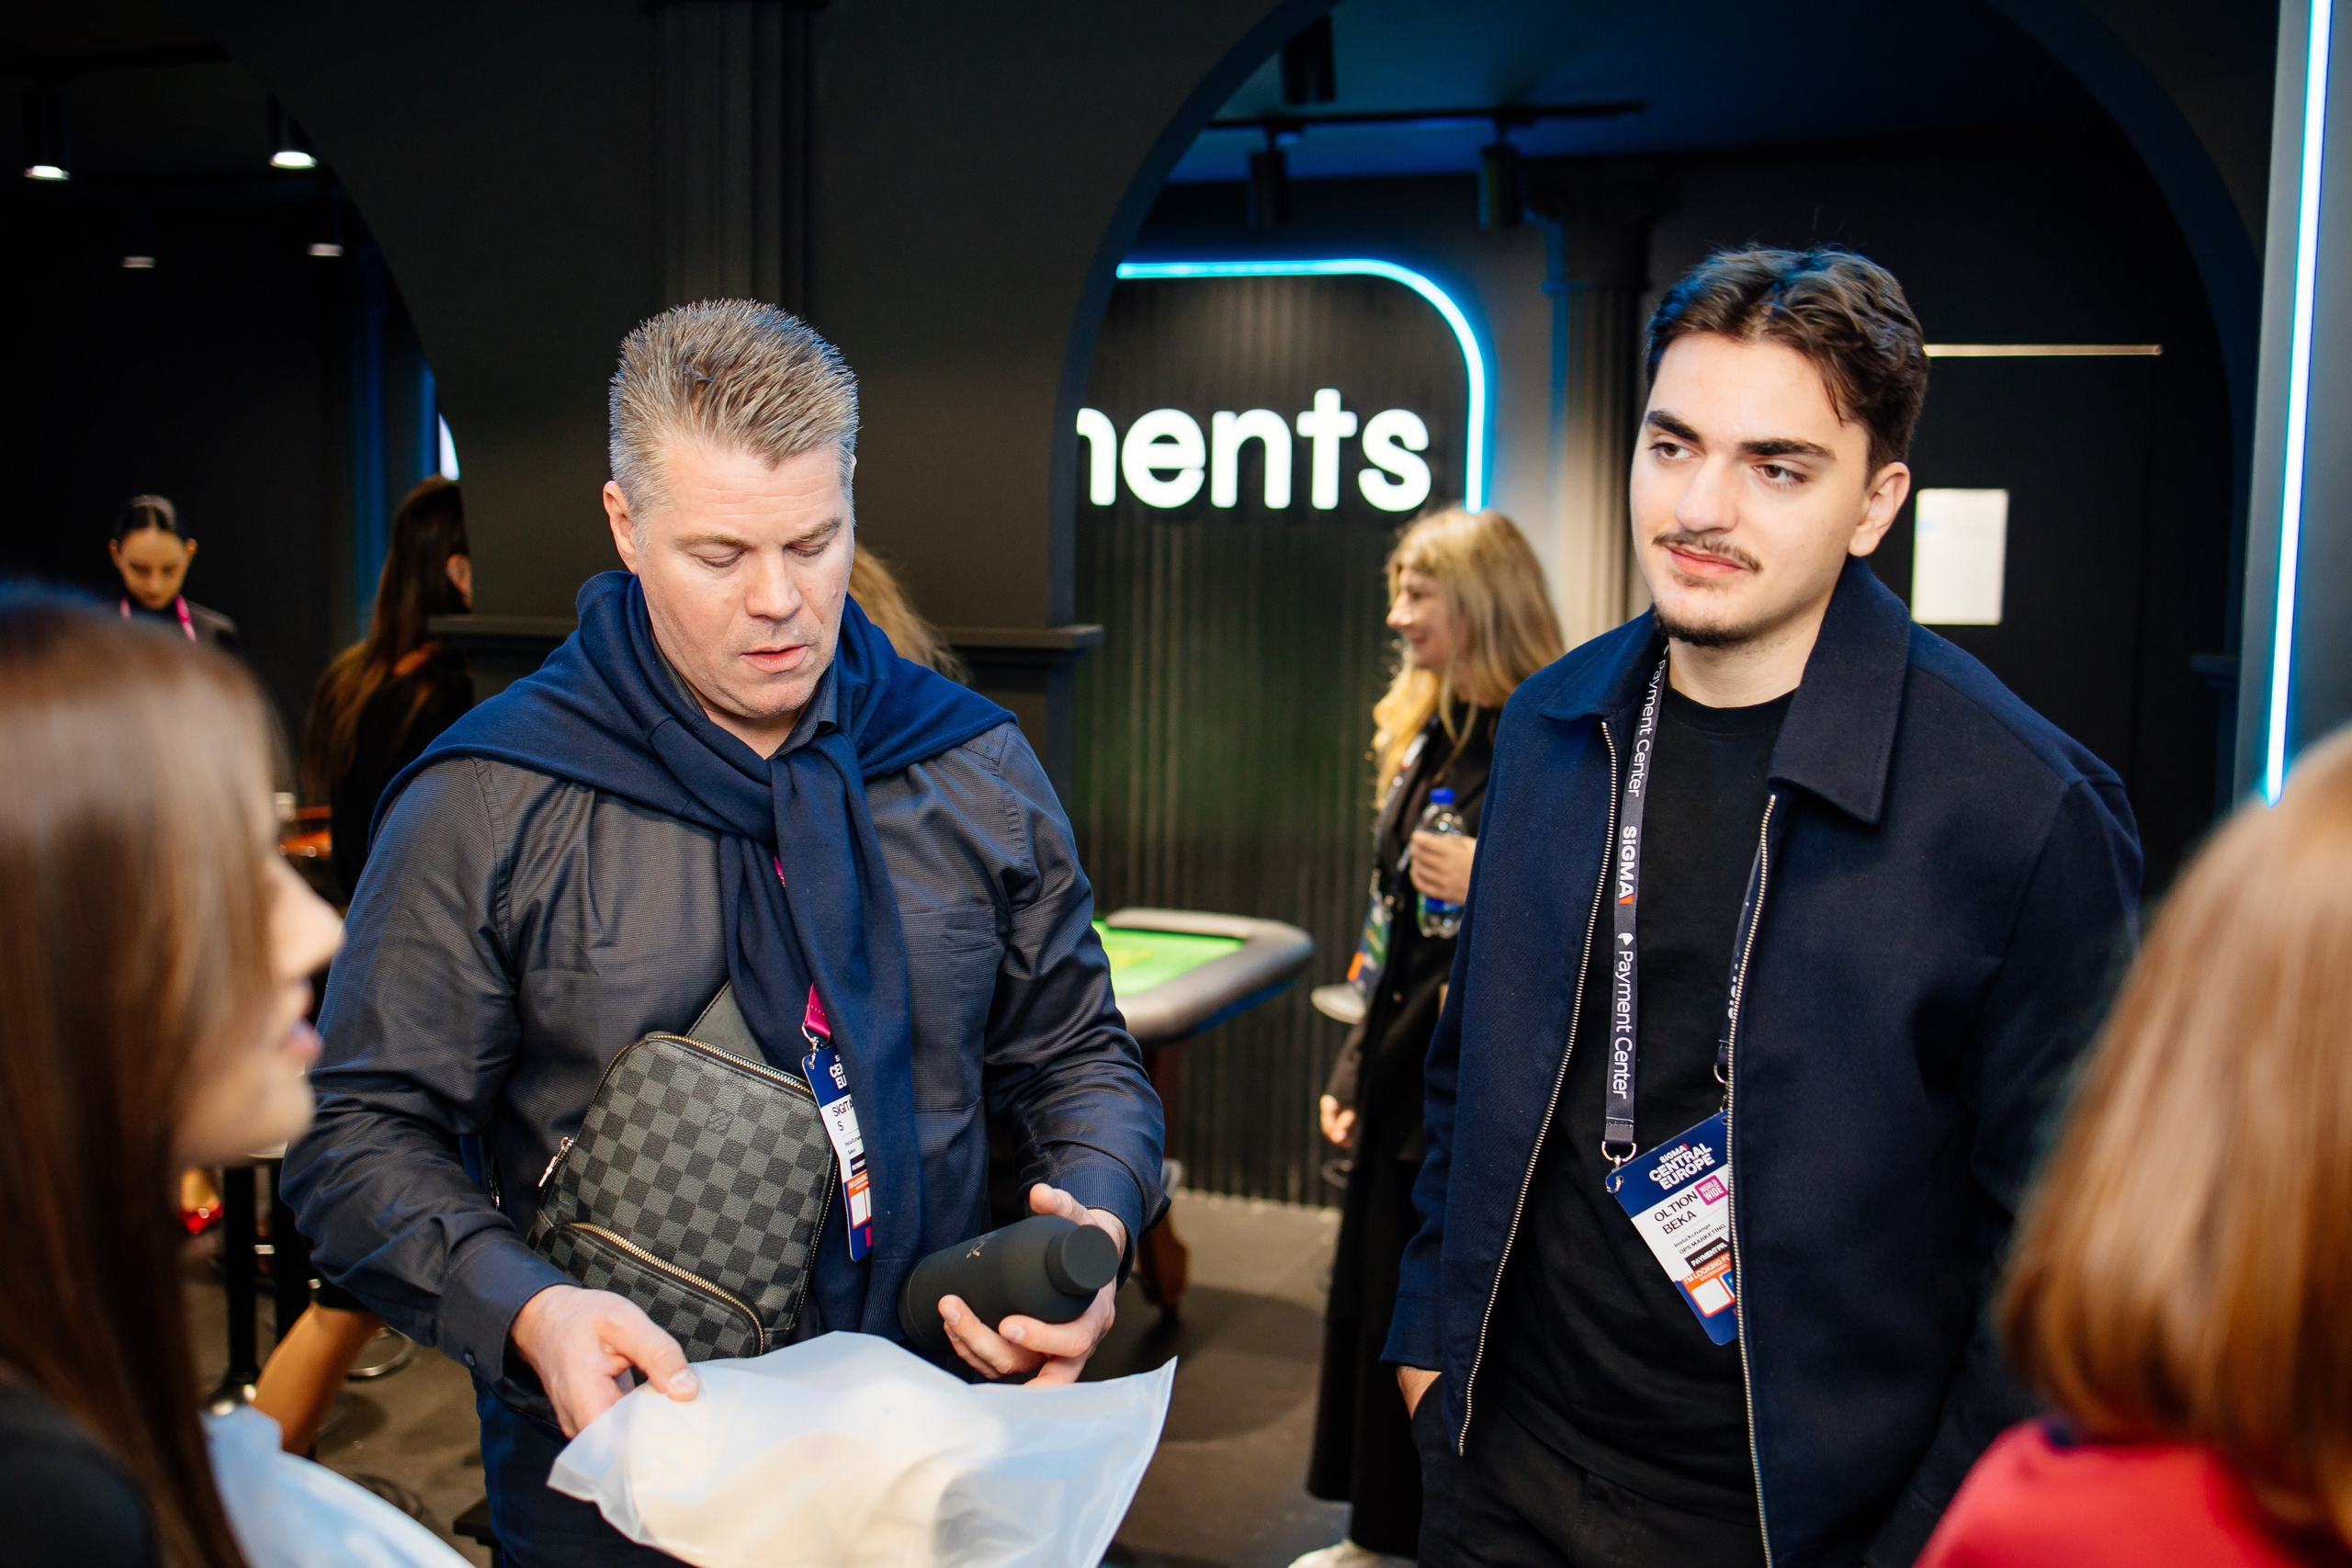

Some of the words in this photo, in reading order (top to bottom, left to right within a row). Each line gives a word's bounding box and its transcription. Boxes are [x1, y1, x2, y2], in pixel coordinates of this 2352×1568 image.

[1639, 660, 1667, 735] Payment
[1628, 739, 1650, 798] Center
[1614, 951, 1634, 1033] Payment
[1612, 1038, 1634, 1100] Center
[1649, 1143, 1713, 1181] CENTRAL
[1658, 1153, 1715, 1190] EUROPE
[1698, 1179, 1718, 1193] WORLD
[1703, 1186, 1724, 1202] WIDE
[1654, 1190, 1698, 1222] OLTION
[1662, 1211, 1697, 1235] BEKA
[1690, 1224, 1726, 1247] MARKETING
[1693, 1259, 1723, 1280] LOOKING
